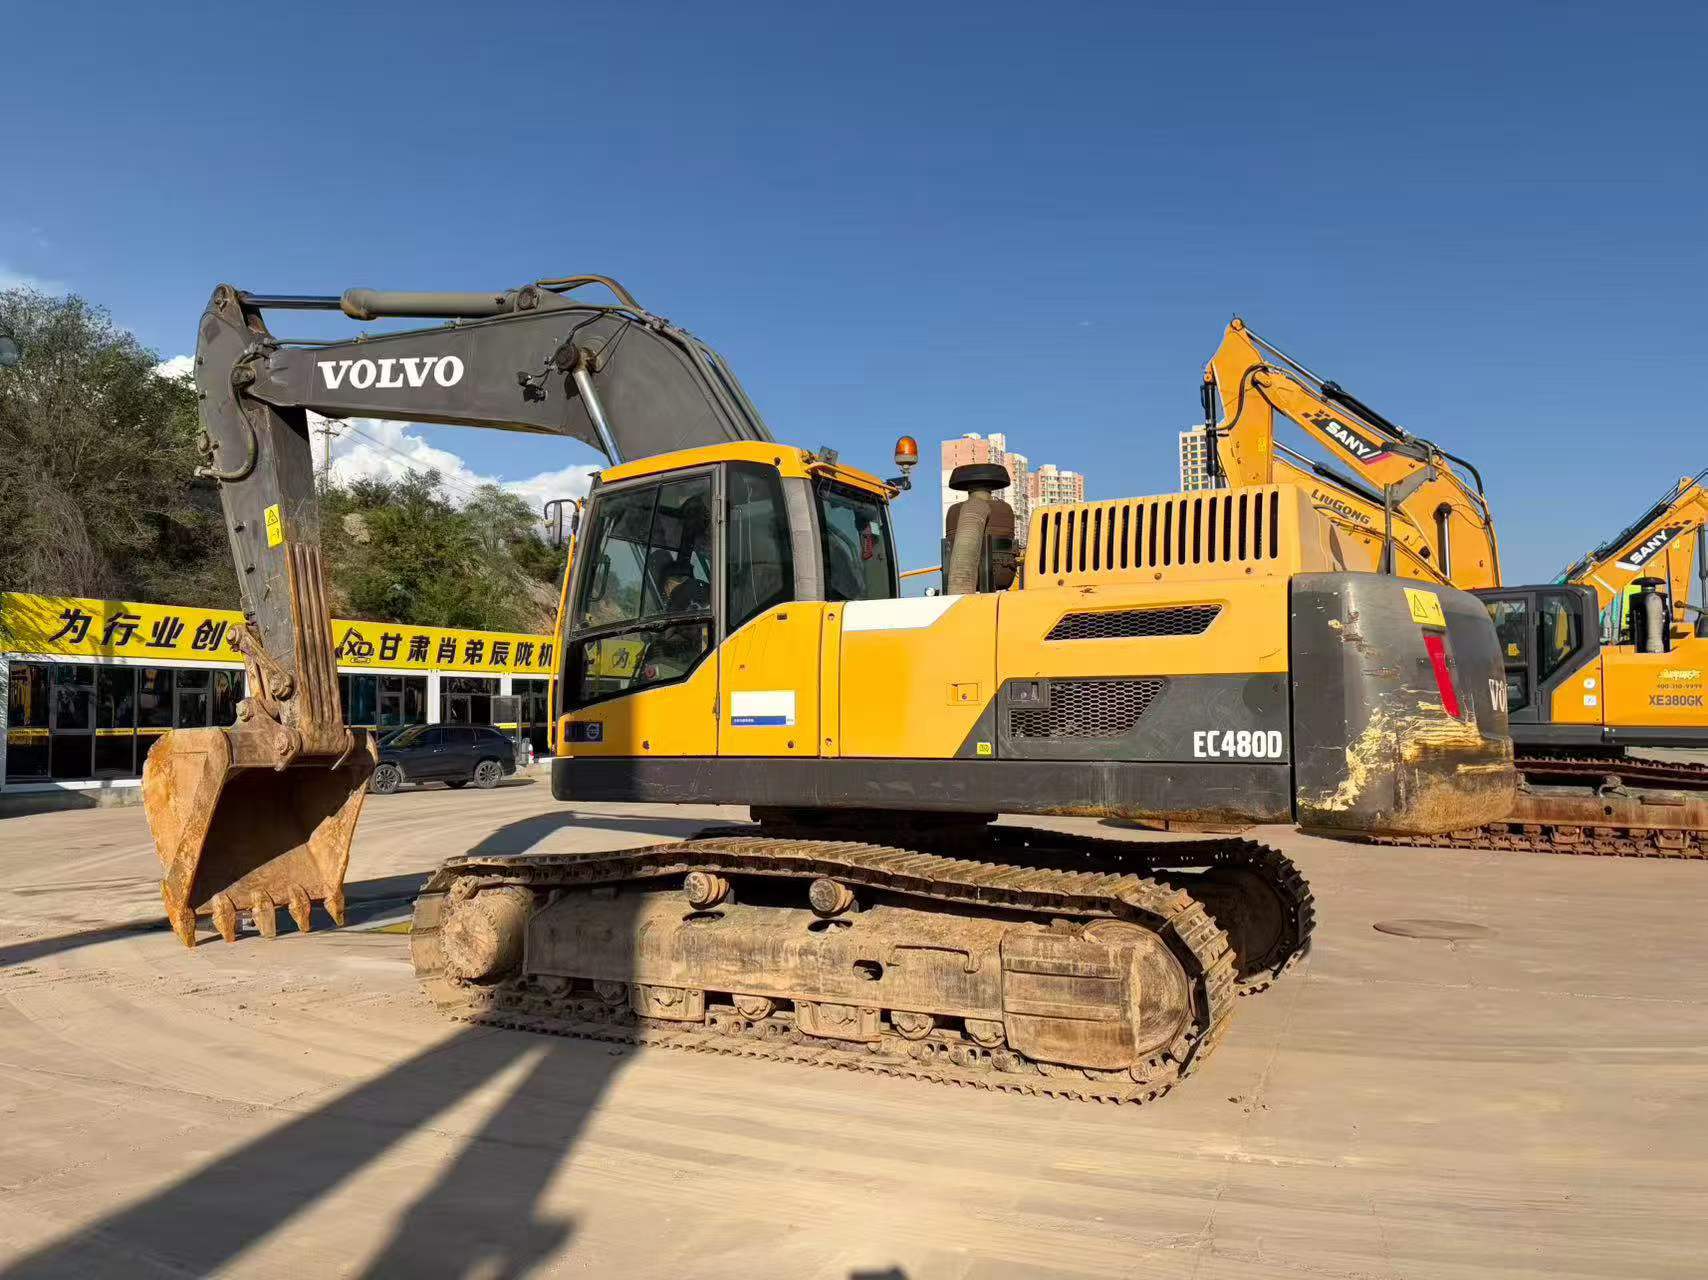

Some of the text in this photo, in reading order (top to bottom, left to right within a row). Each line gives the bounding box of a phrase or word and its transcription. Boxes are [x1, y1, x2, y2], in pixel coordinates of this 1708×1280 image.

[317, 355, 465, 390] VOLVO
[1325, 421, 1371, 456] SANY
[1629, 529, 1668, 564] SANY
[48, 608, 228, 652] 为行业创
[1648, 694, 1704, 706] XE380GK
[1193, 730, 1283, 758] EC480D
